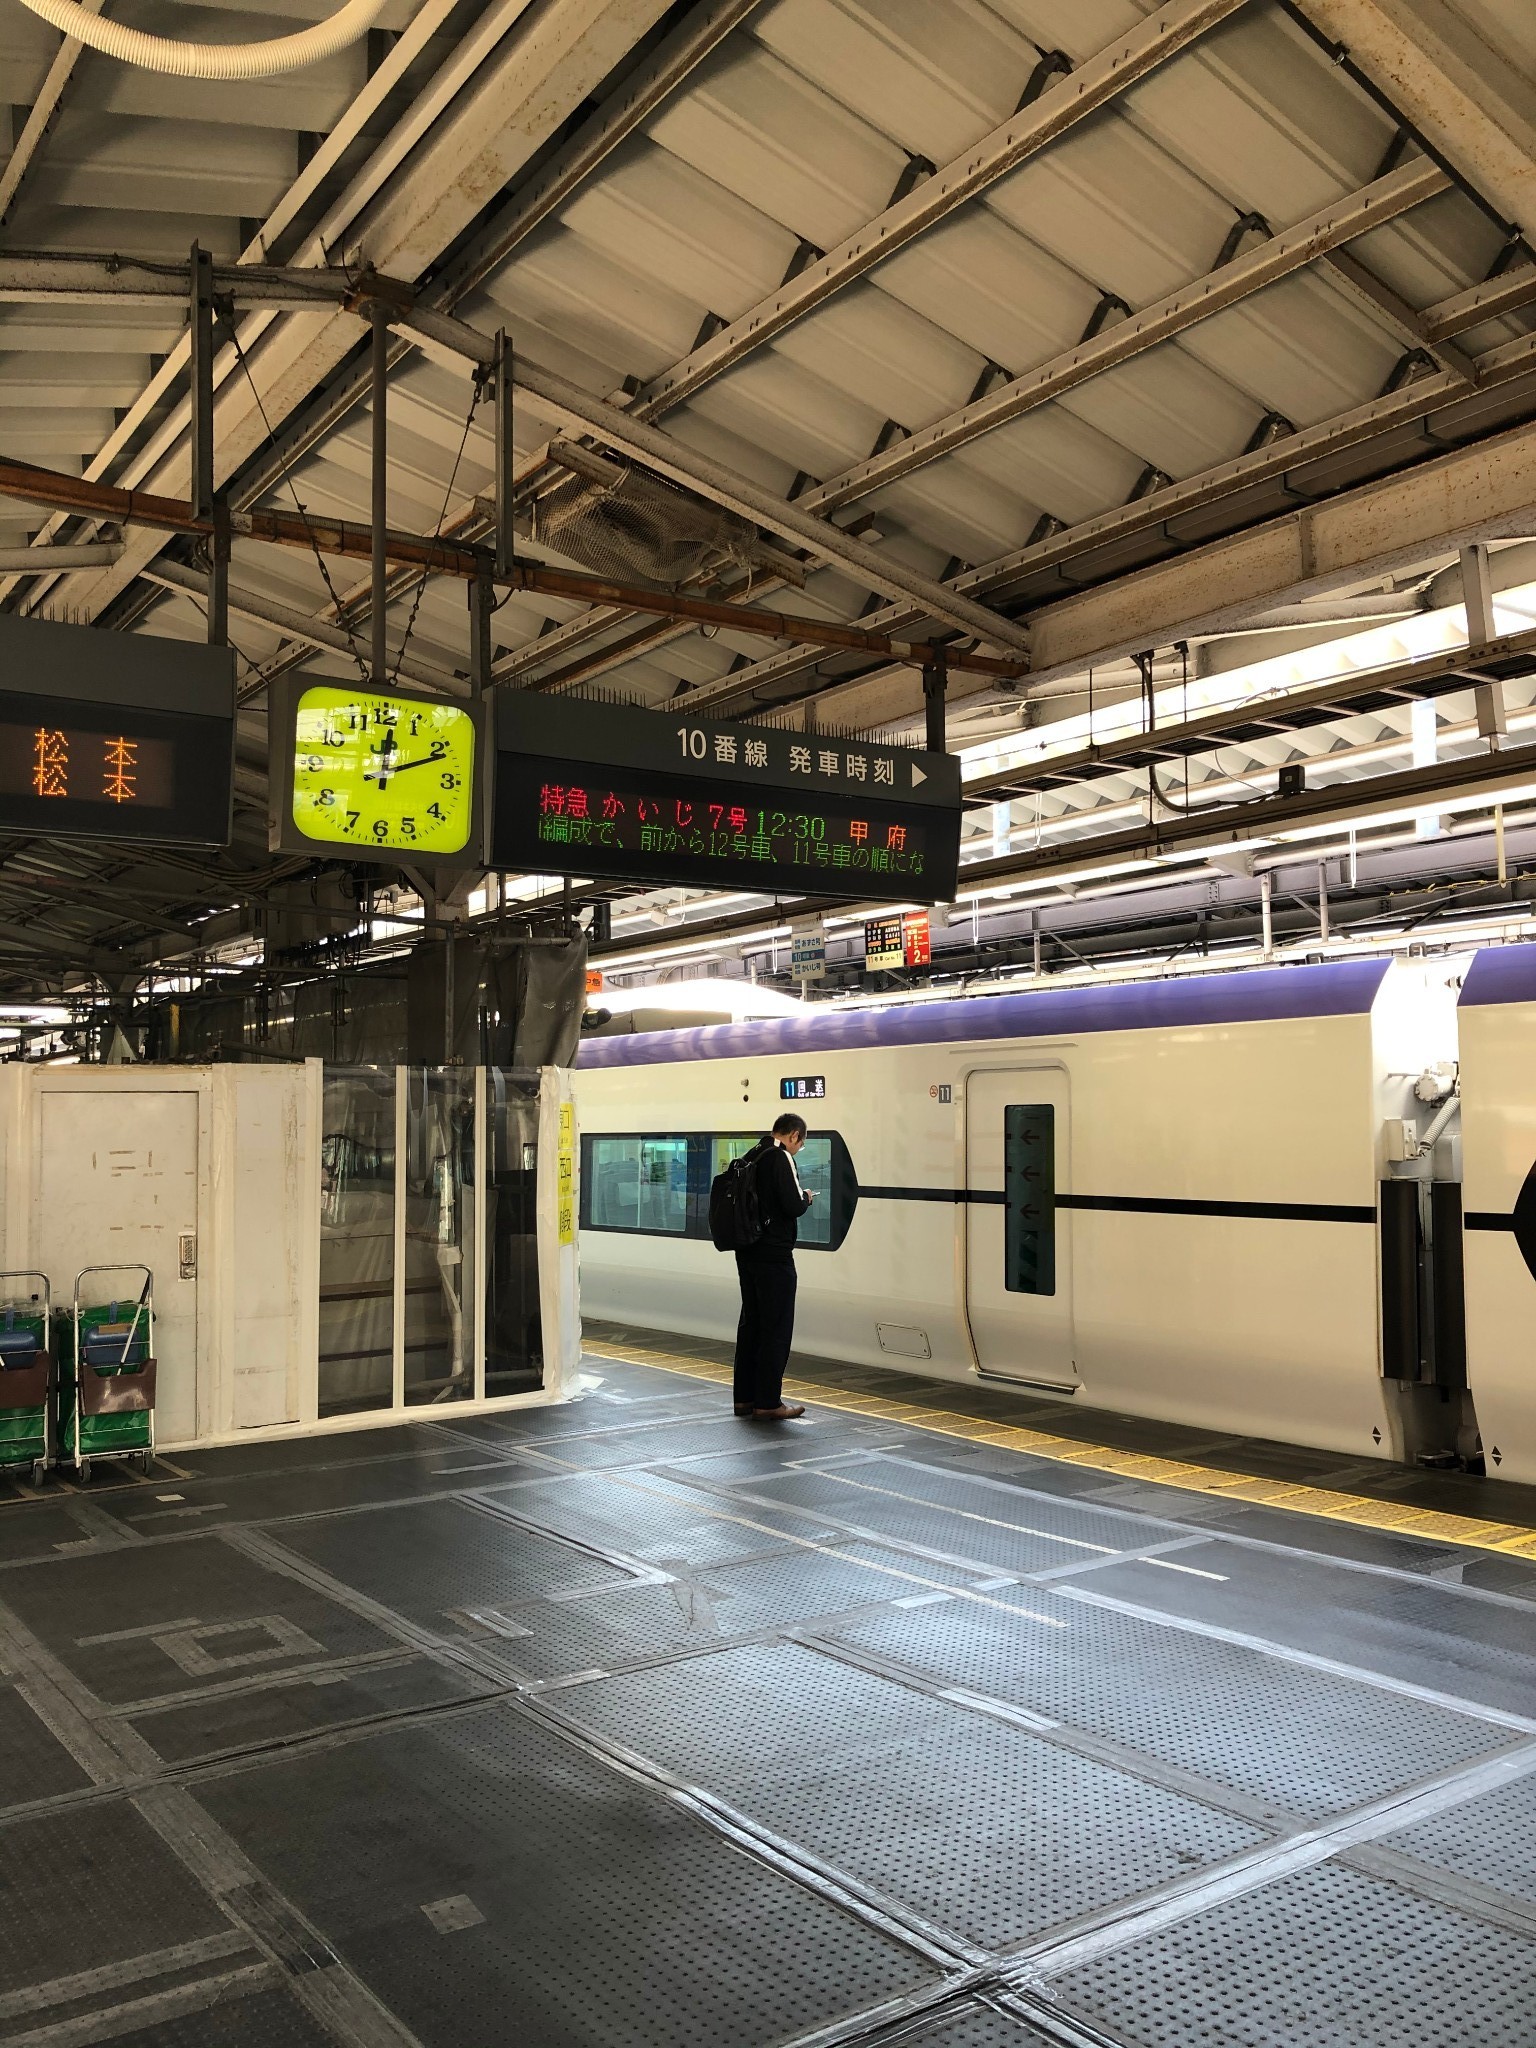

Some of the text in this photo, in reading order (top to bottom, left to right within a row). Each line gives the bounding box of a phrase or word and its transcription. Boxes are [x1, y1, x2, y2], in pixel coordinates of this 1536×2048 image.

[348, 715, 367, 731] 11
[374, 708, 397, 726] 12
[409, 719, 419, 736] 1
[321, 729, 345, 748] 10
[430, 741, 446, 757] 2
[676, 728, 895, 786] 10番線 発車時刻
[307, 755, 325, 773] 9
[440, 773, 455, 790] 3
[318, 788, 335, 806] 8
[426, 802, 442, 819] 4
[540, 784, 589, 818] 特急
[757, 810, 826, 841] 12:30
[346, 811, 361, 828] 7
[400, 817, 416, 834] 5
[372, 820, 389, 837] 6
[914, 949, 921, 963] 2
[785, 1081, 795, 1097] 11
[940, 1087, 950, 1101] 11
